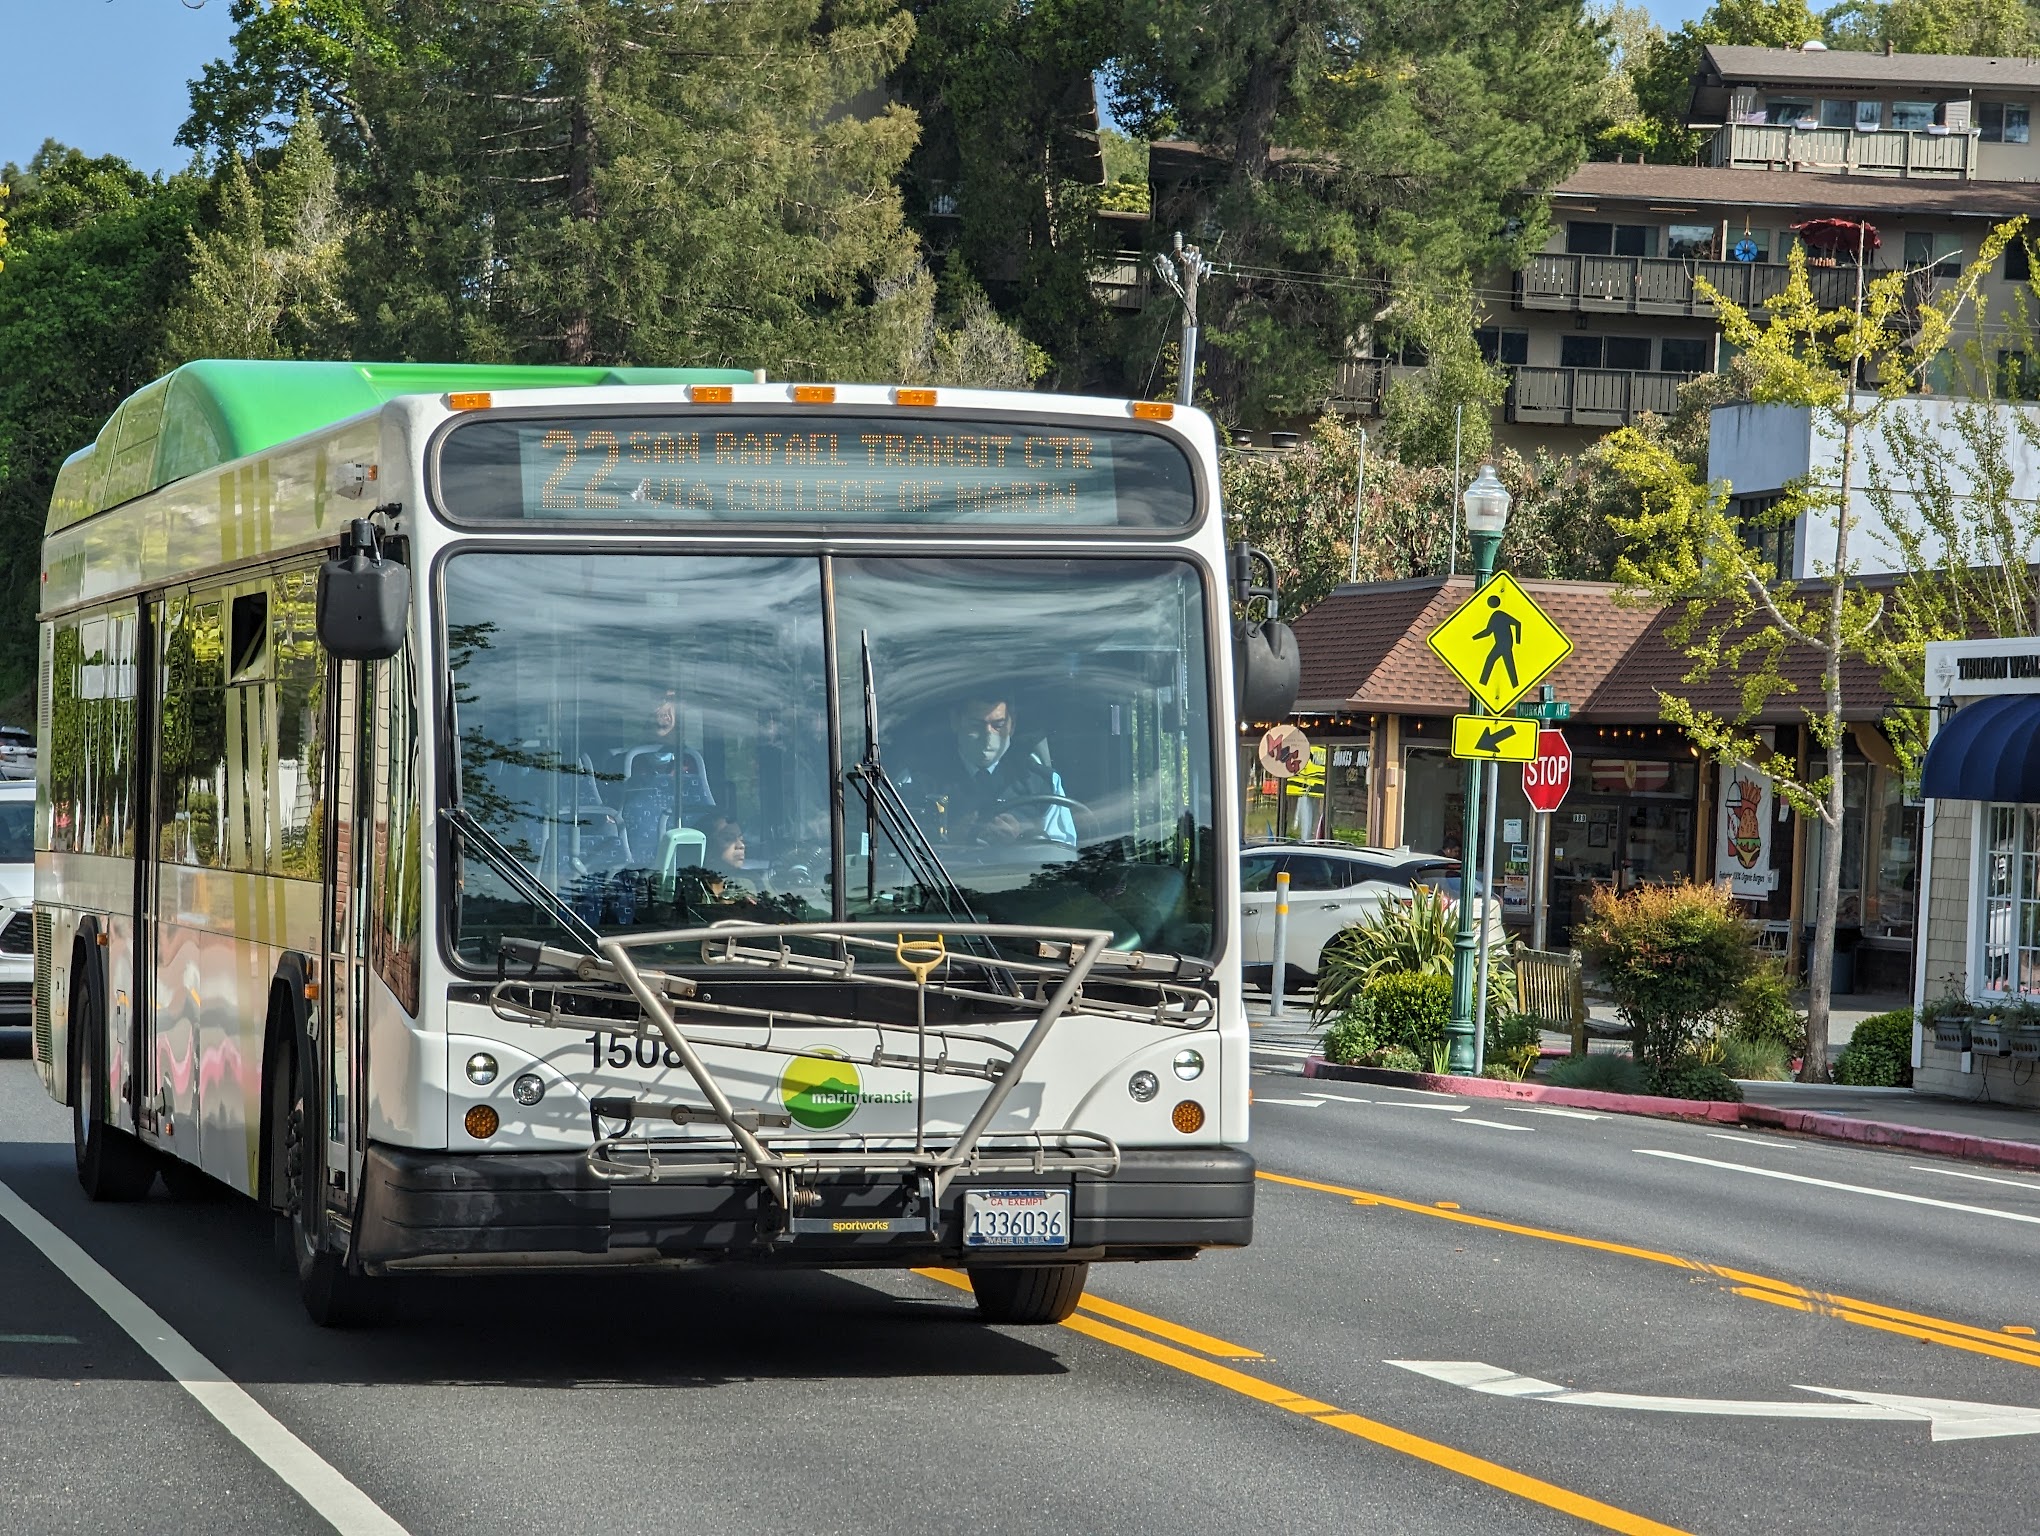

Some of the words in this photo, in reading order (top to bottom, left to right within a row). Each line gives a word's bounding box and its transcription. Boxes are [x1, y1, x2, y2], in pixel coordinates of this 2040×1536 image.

[629, 431, 700, 464] SAN
[716, 432, 848, 466] RAFAEL
[861, 434, 1012, 467] TRANSIT
[1025, 436, 1093, 469] CTR
[541, 429, 621, 509] 22
[644, 477, 713, 510] VIA
[727, 478, 885, 512] COLLEGE
[899, 480, 943, 512] OF
[956, 481, 1076, 514] MARIN
[1519, 704, 1547, 717] MURRAY
[1555, 703, 1567, 716] AVE
[1526, 755, 1569, 786] STOP
[585, 1030, 686, 1069] 1508
[811, 1089, 859, 1104] marin
[861, 1090, 913, 1104] transit
[990, 1198, 1004, 1206] CA
[1008, 1197, 1044, 1206] EXEMPT
[832, 1220, 889, 1232] sportworks
[972, 1210, 1062, 1237] 1336036
[988, 1236, 1014, 1245] MADE
[1016, 1236, 1025, 1245] IN
